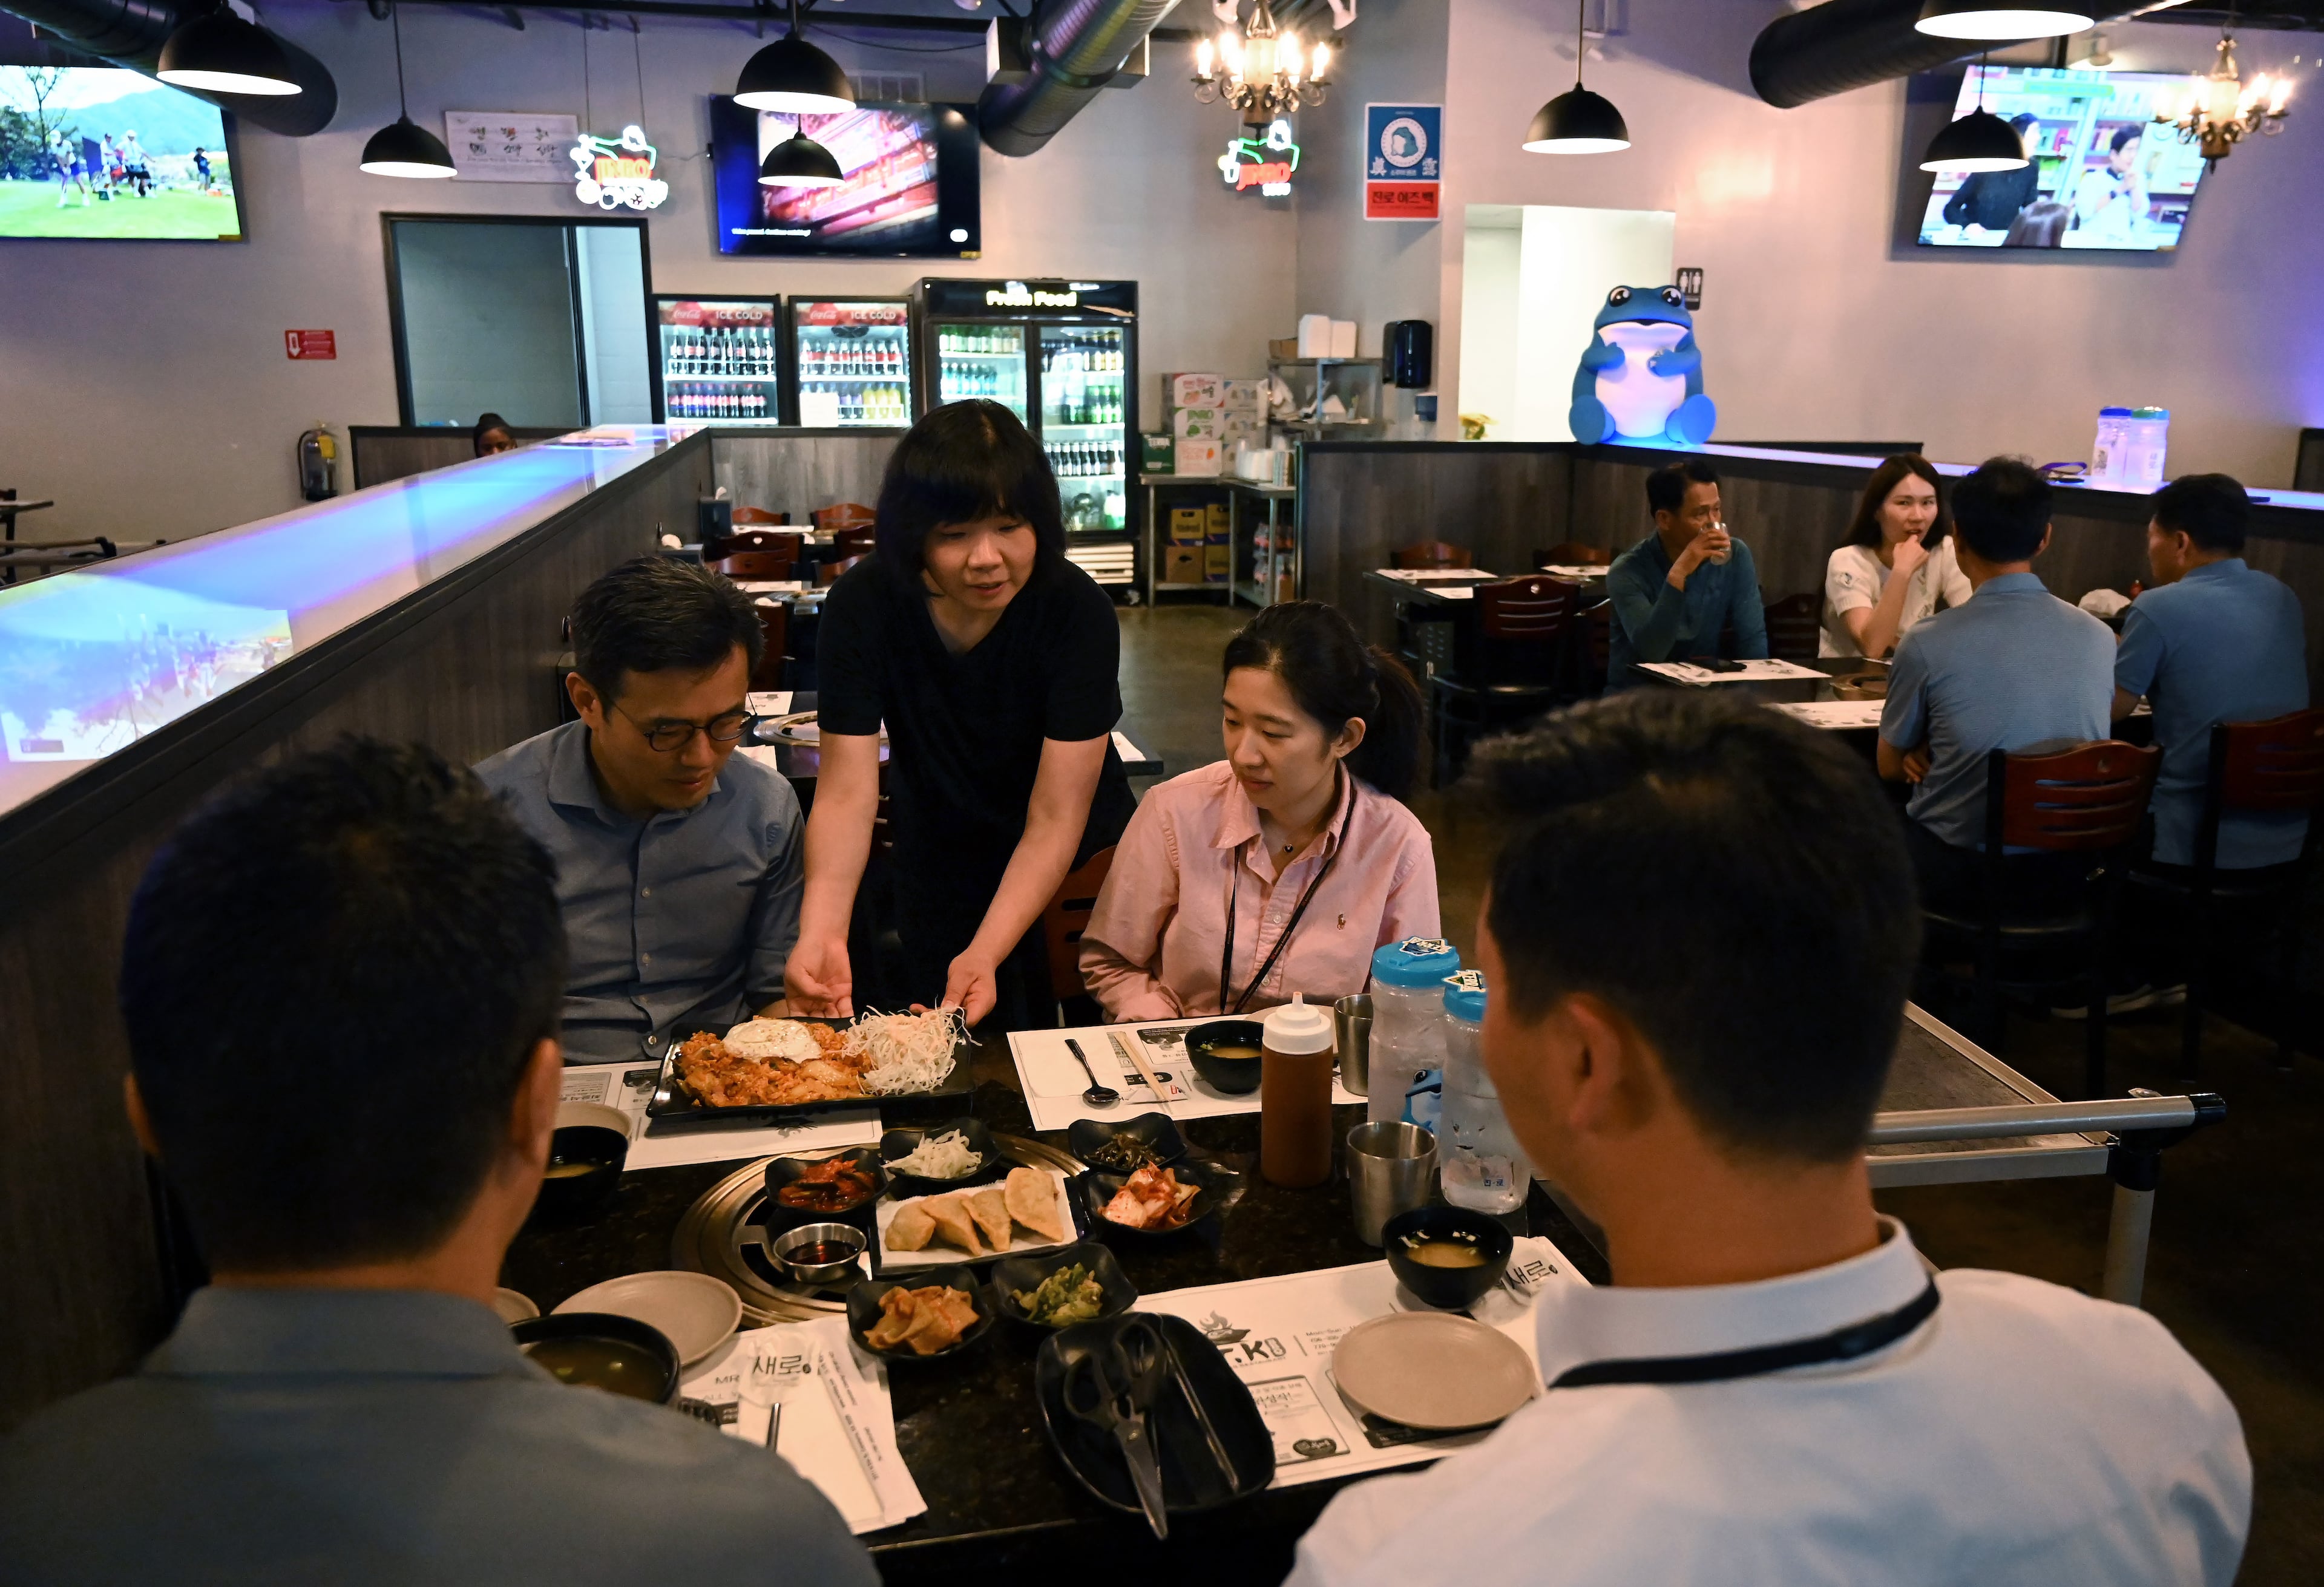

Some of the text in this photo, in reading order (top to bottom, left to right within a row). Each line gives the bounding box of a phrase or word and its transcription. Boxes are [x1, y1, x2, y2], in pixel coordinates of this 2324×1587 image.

[986, 290, 1077, 306] Fresh Food
[716, 310, 763, 319] ICE COLD
[810, 310, 836, 319] Coca-Cola
[851, 310, 896, 319] ICE COLD
[752, 1354, 803, 1375] 새로
